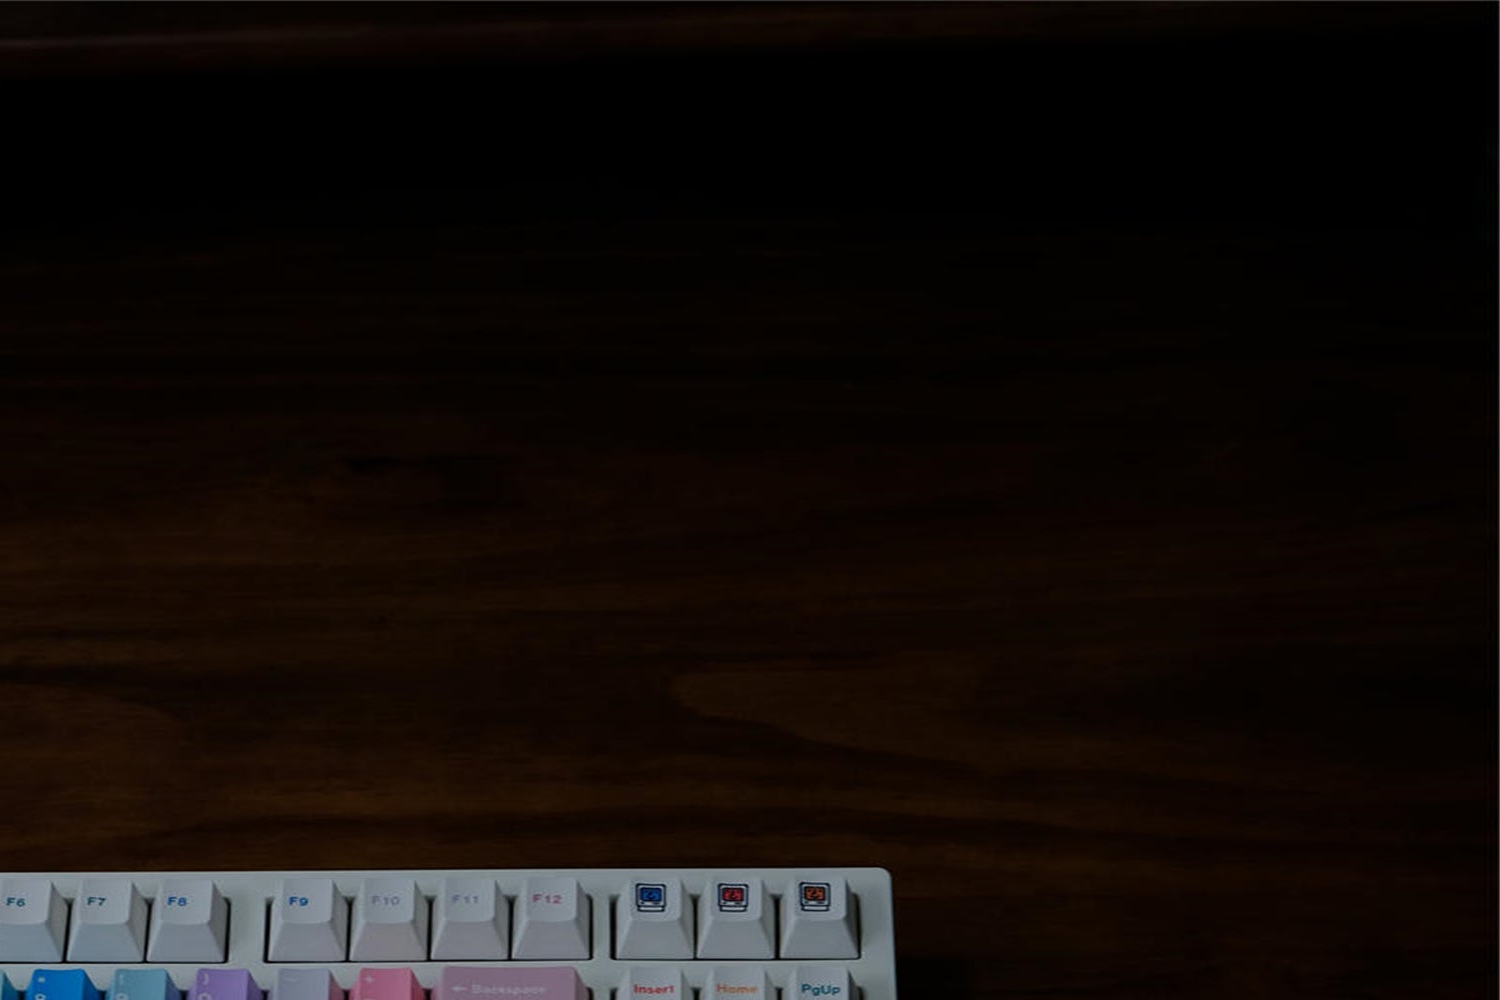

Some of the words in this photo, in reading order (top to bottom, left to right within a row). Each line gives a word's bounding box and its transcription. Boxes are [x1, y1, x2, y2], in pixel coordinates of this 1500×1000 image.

[6, 897, 26, 907] F6
[87, 897, 106, 906] F7
[168, 896, 188, 906] F8
[289, 896, 309, 906] F9
[372, 895, 400, 905] F10
[453, 895, 480, 904] F11
[532, 894, 562, 904] F12
[716, 982, 757, 994] Home
[801, 983, 841, 996] PgUp
